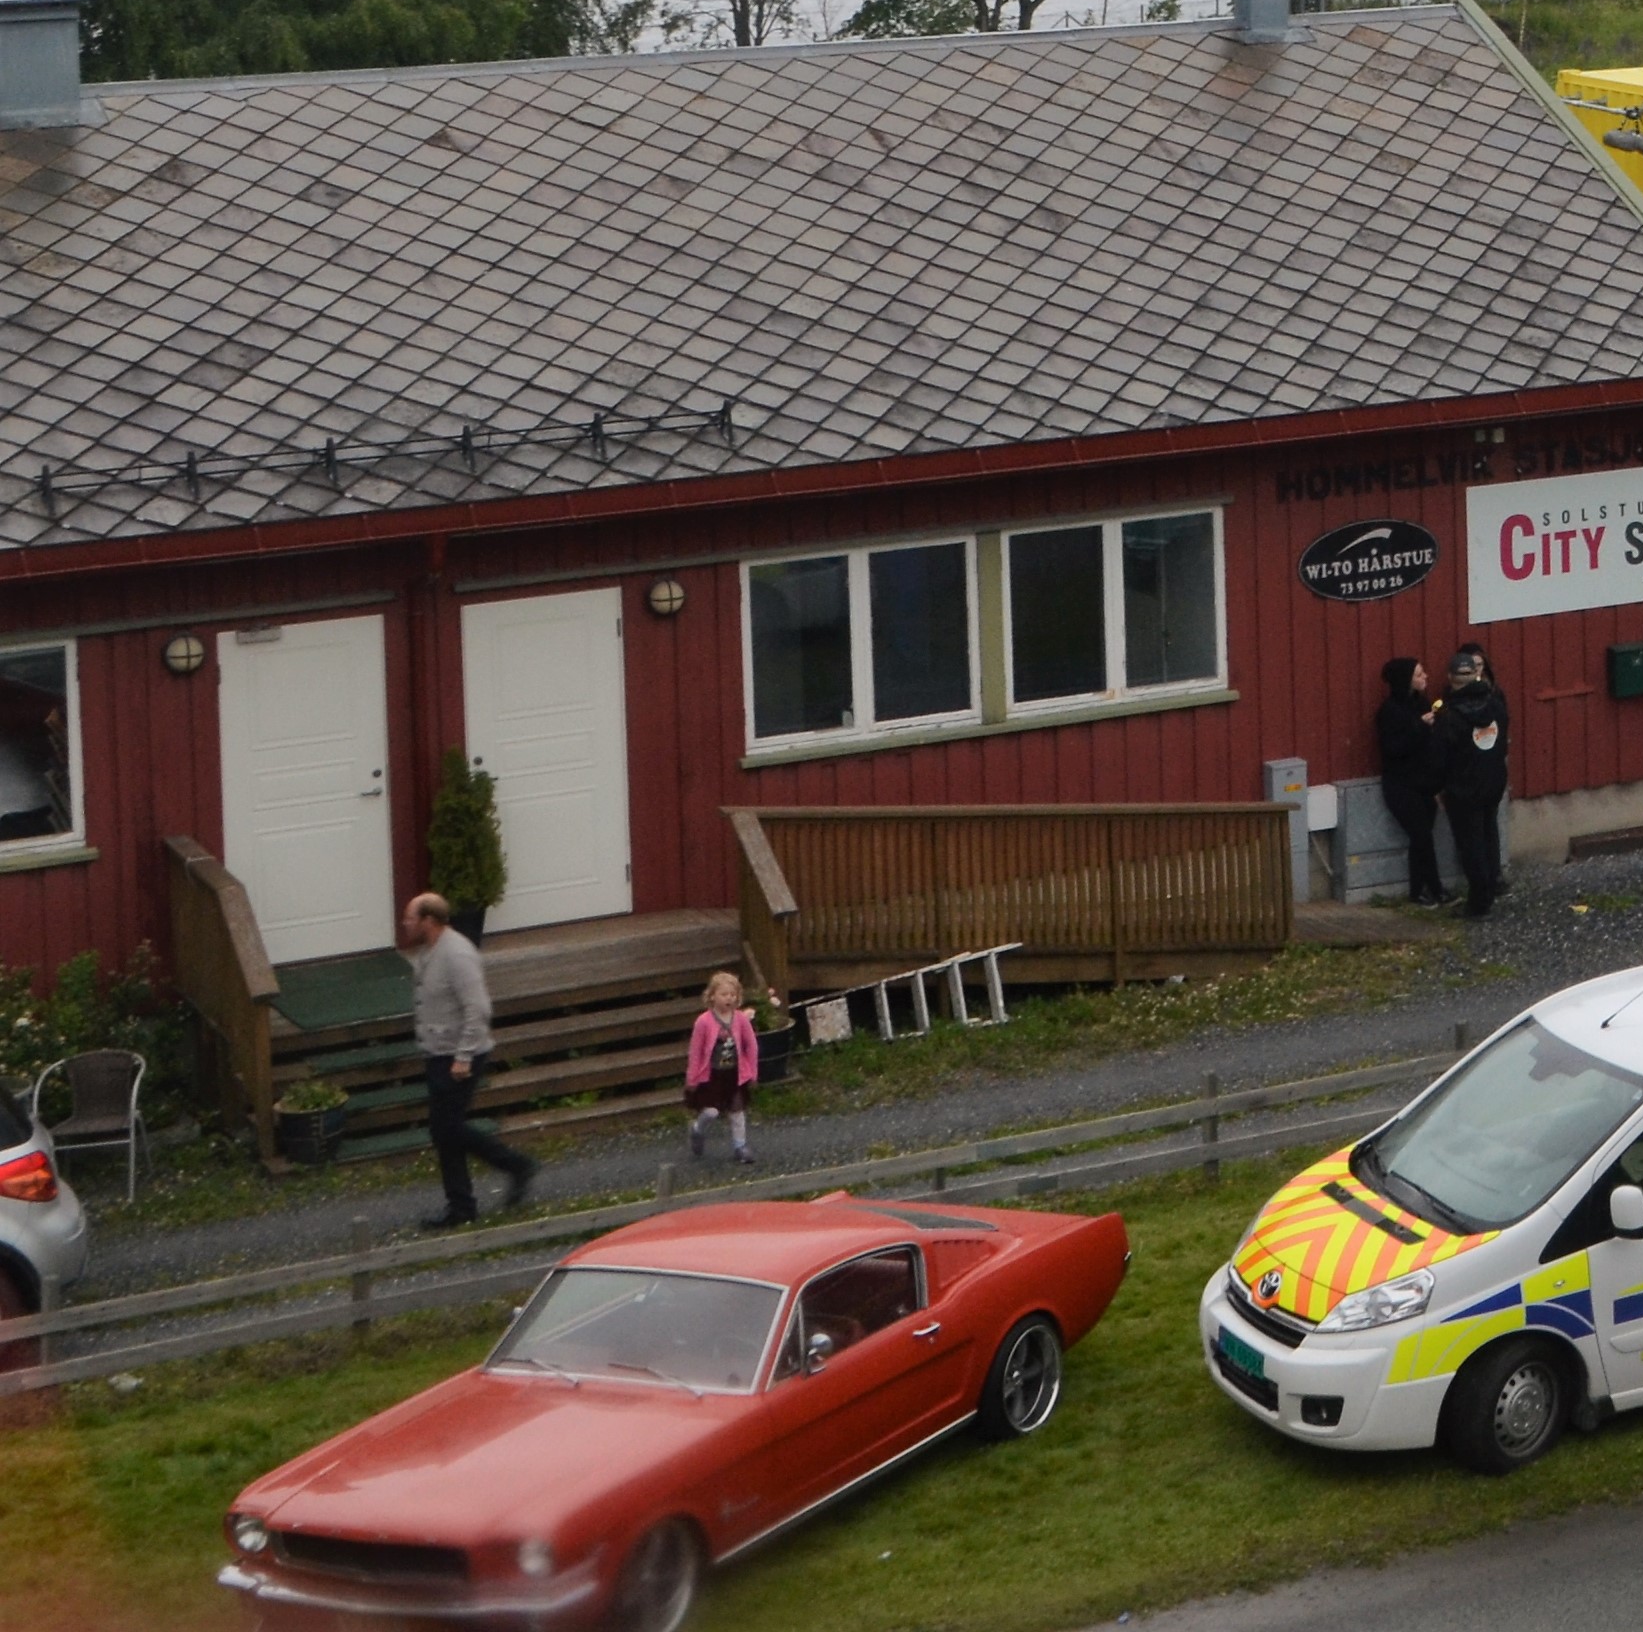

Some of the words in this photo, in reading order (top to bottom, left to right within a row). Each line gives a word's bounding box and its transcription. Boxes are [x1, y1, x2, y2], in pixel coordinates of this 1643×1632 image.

[1276, 446, 1496, 504] HOMMELVIK
[1358, 548, 1433, 573] HÅRSTUE
[1499, 514, 1606, 581] CITY
[1356, 580, 1369, 592] 97
[1372, 578, 1386, 590] 00
